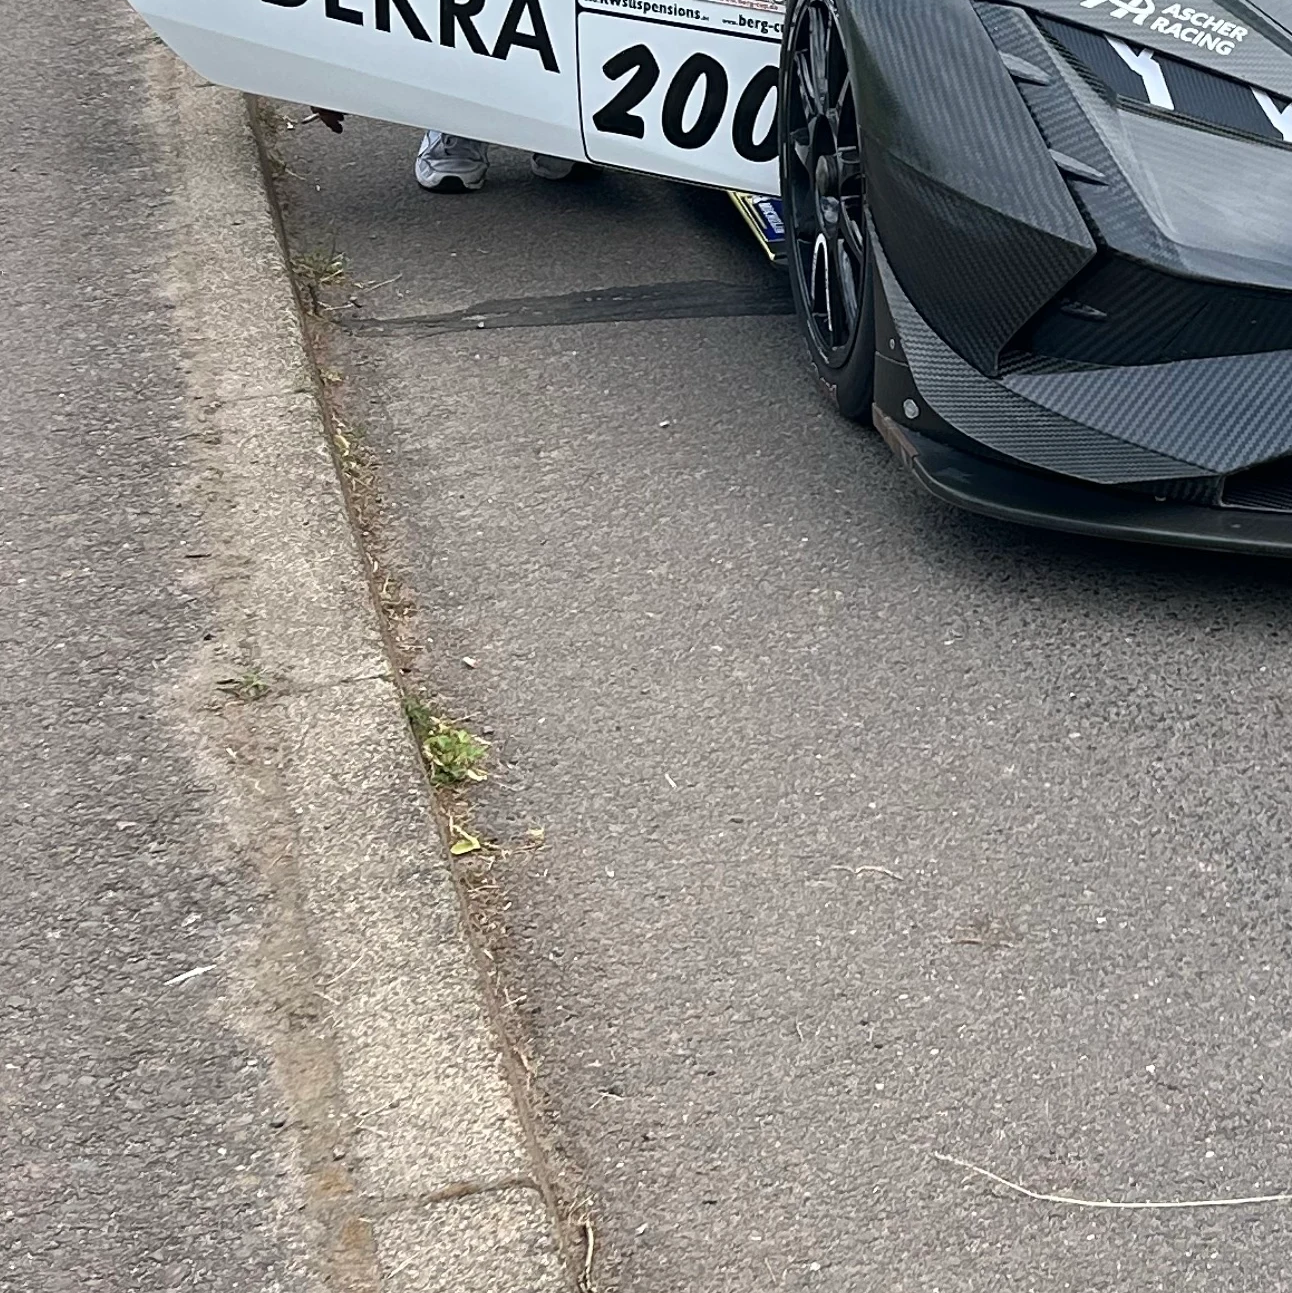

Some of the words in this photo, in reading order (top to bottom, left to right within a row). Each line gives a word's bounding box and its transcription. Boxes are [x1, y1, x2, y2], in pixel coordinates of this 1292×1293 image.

[1149, 16, 1236, 56] RACING
[1161, 3, 1248, 42] ASCHER
[592, 43, 780, 163] 200
